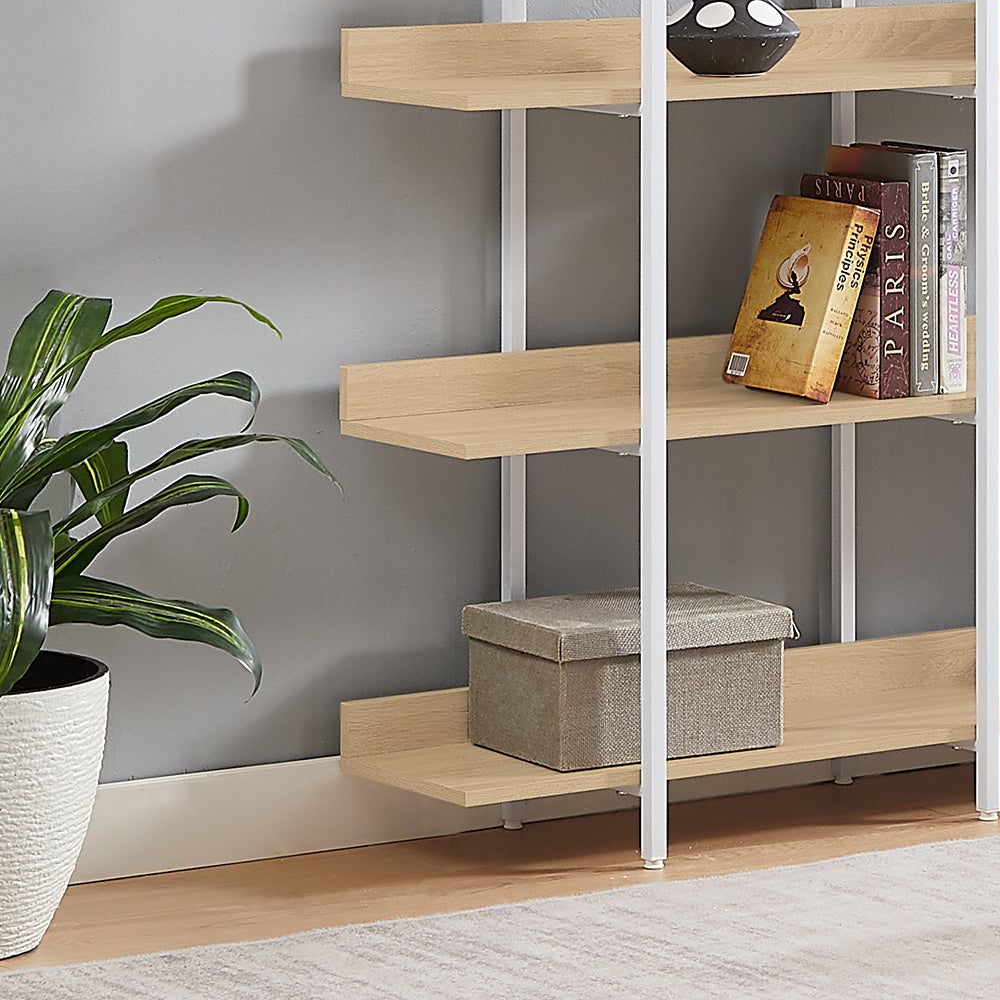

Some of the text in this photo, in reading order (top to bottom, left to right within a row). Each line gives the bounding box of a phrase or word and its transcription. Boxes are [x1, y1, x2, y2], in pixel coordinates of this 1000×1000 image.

[815, 178, 867, 203] PARIS
[836, 222, 864, 292] Principles
[850, 234, 874, 289] Physics
[884, 223, 906, 358] PARIS
[920, 181, 931, 371] Bride & Groom's wedding
[948, 269, 960, 356] HEARTLESS
